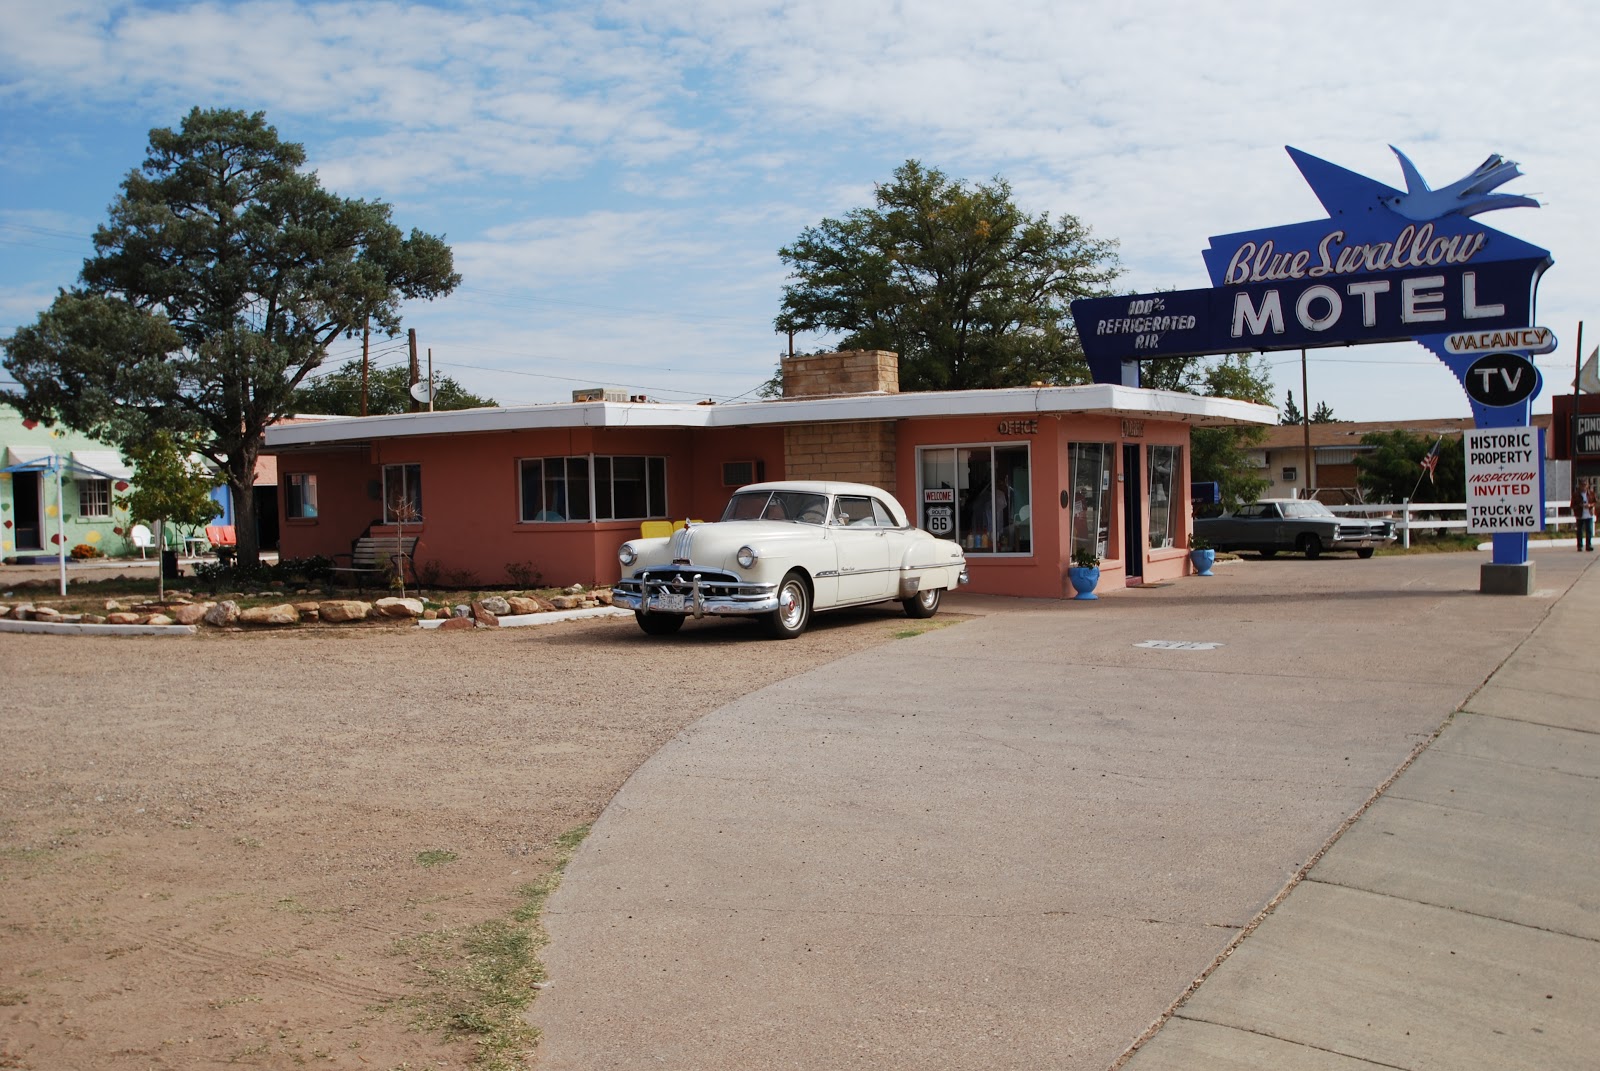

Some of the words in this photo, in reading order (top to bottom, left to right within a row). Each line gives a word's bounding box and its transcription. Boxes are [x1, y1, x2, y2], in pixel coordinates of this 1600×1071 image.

[1224, 240, 1310, 285] Blue
[1309, 223, 1489, 277] Swallow
[1128, 298, 1165, 315] 100%
[1231, 272, 1505, 337] MOTEL
[1097, 315, 1196, 335] REFRIGERATED
[1135, 334, 1159, 349] AIR
[1451, 328, 1549, 350] VACANCY
[1474, 367, 1523, 393] TV
[999, 420, 1038, 435] OFFICE
[1470, 434, 1531, 449] HISTORIC
[1471, 450, 1532, 465] PROPERTY
[1469, 472, 1536, 483] INSPECTION
[926, 491, 952, 501] WELCOME
[1474, 484, 1530, 496] INVITED
[1471, 505, 1512, 516] TRUCK
[1518, 504, 1533, 514] RV
[932, 517, 947, 530] 66
[1472, 516, 1535, 528] PARKING
